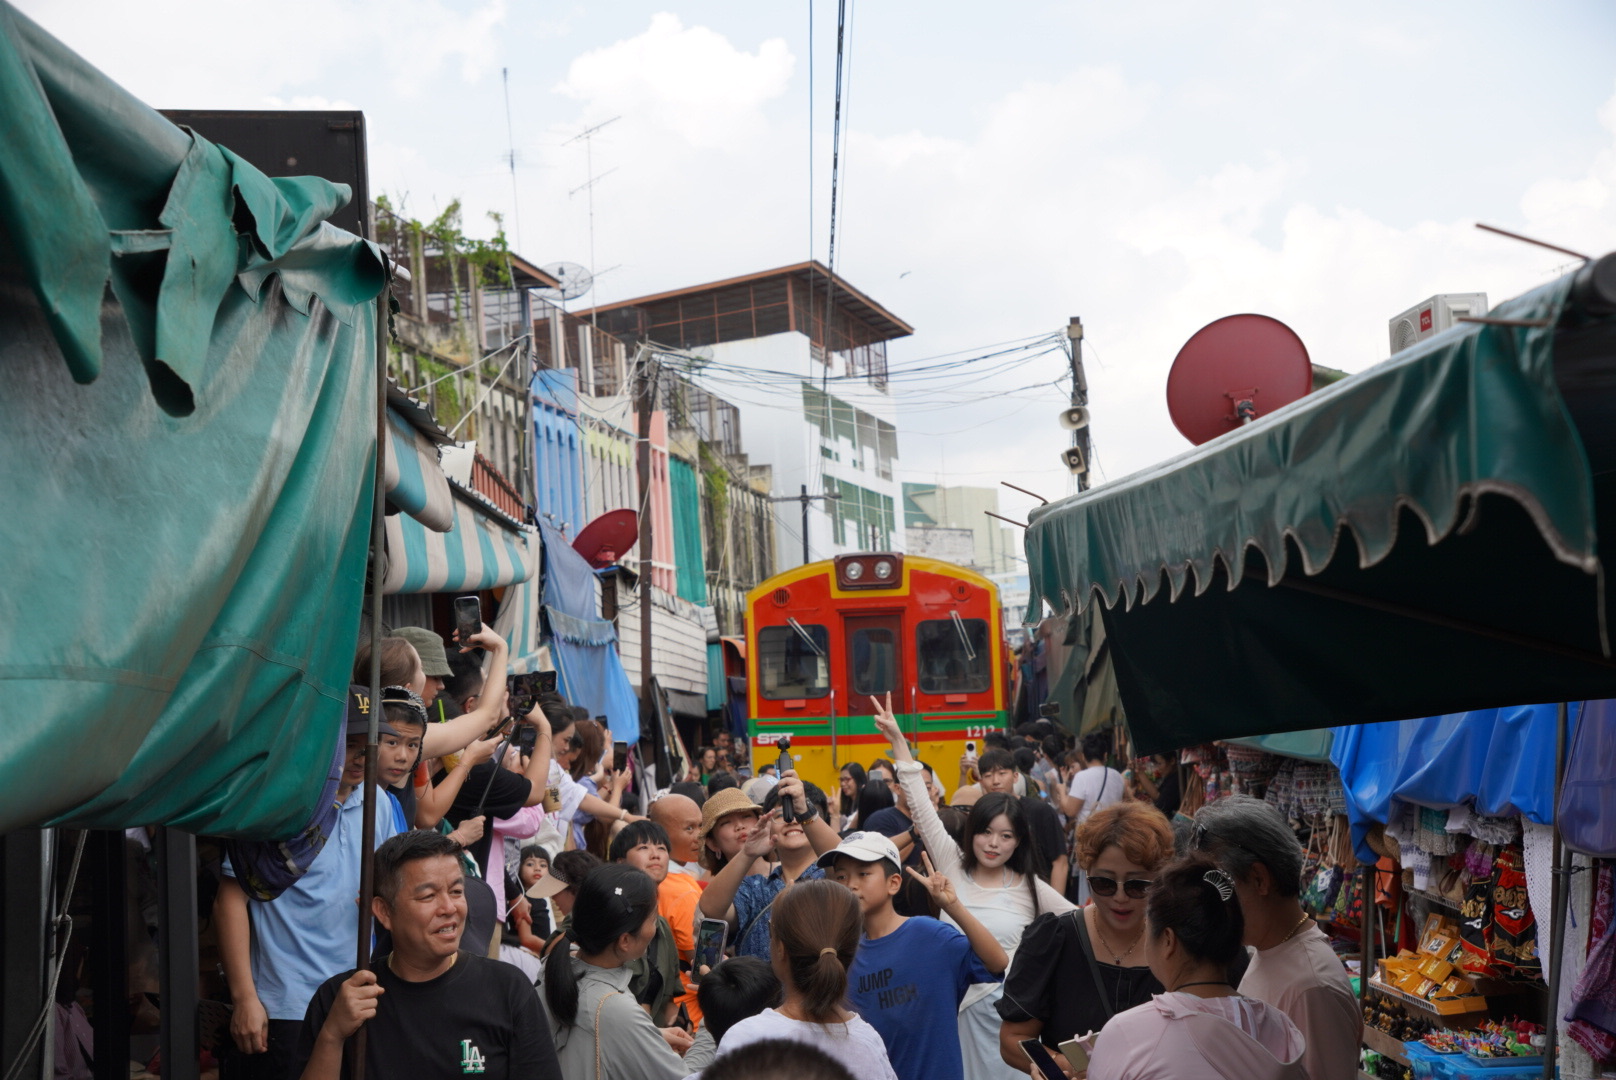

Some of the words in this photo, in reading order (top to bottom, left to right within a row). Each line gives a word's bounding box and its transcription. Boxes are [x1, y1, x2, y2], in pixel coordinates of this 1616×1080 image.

[1421, 316, 1431, 326] TCL
[857, 968, 893, 995] JUMP
[877, 983, 919, 1010] HIGH
[460, 1038, 486, 1074] LA
